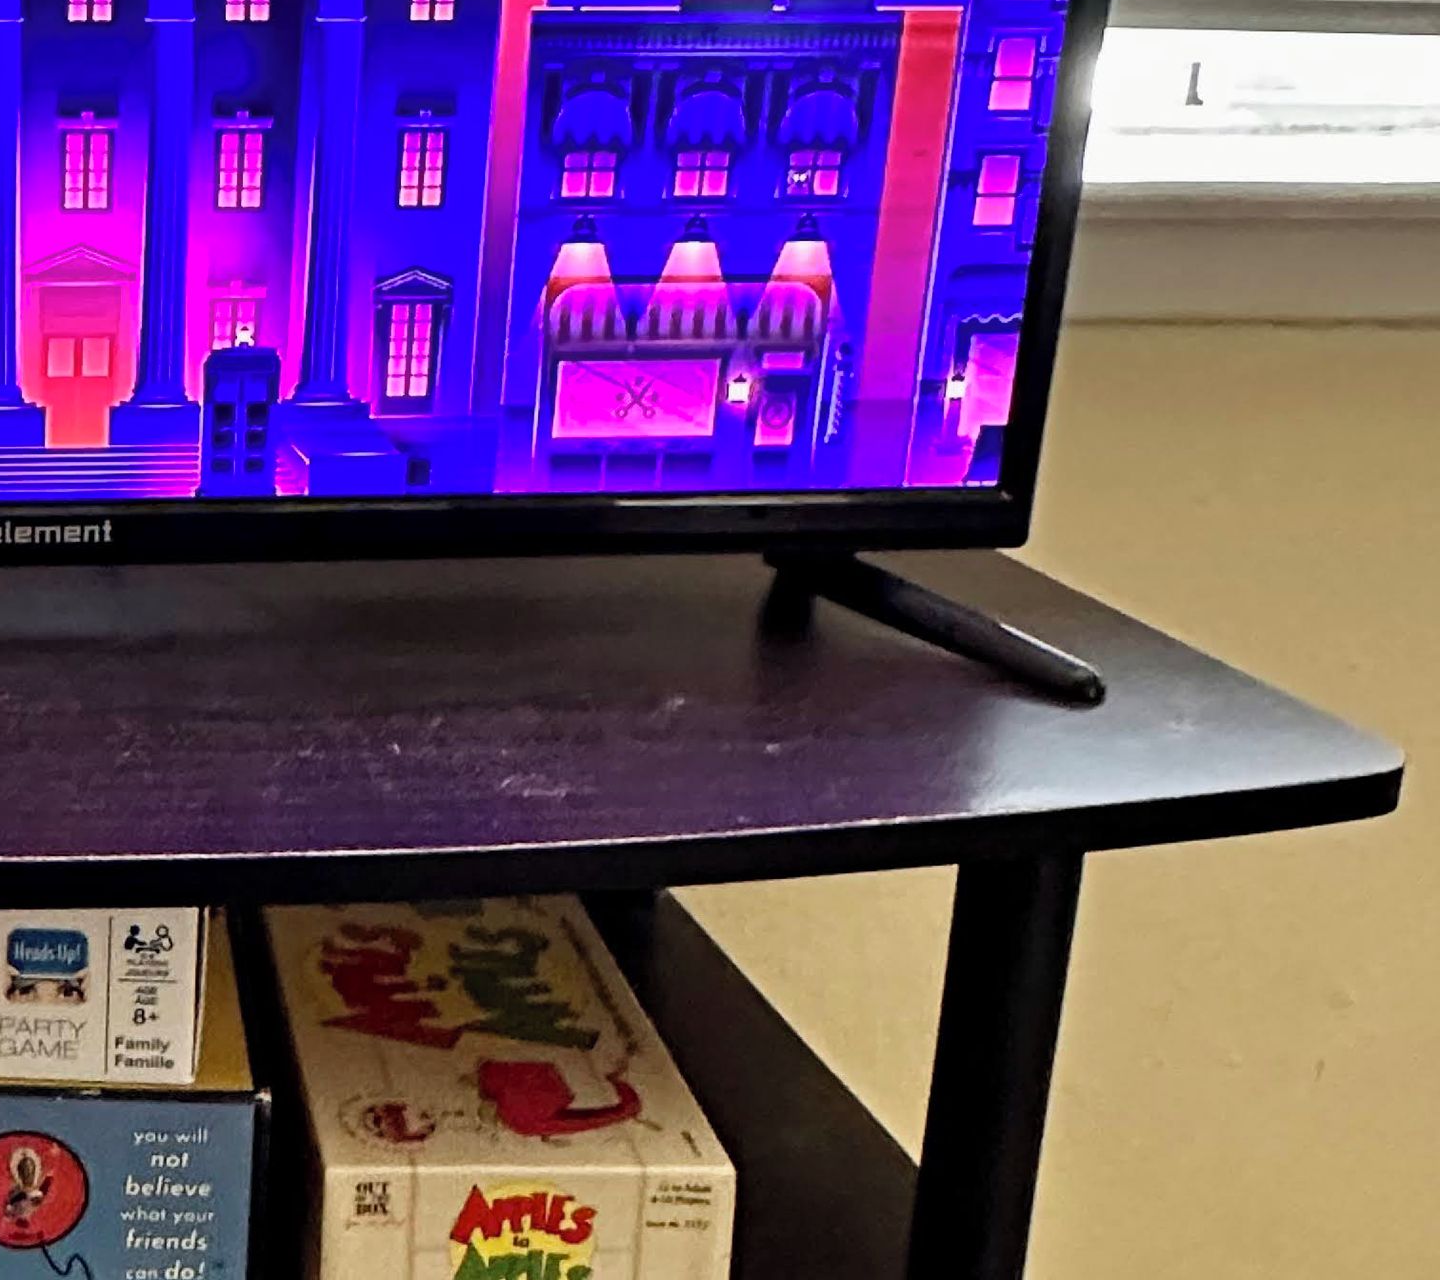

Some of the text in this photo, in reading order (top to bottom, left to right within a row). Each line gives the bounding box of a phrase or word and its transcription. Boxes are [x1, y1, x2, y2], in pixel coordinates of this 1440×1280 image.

[132, 1008, 160, 1025] 8+
[114, 1036, 171, 1054] Family
[114, 1054, 175, 1070] Famille
[134, 1128, 209, 1145] you will
[150, 1152, 189, 1168] not
[125, 1174, 212, 1197] believe
[120, 1208, 215, 1225] what your
[125, 1229, 209, 1251] friends
[125, 1260, 206, 1280] can do!
